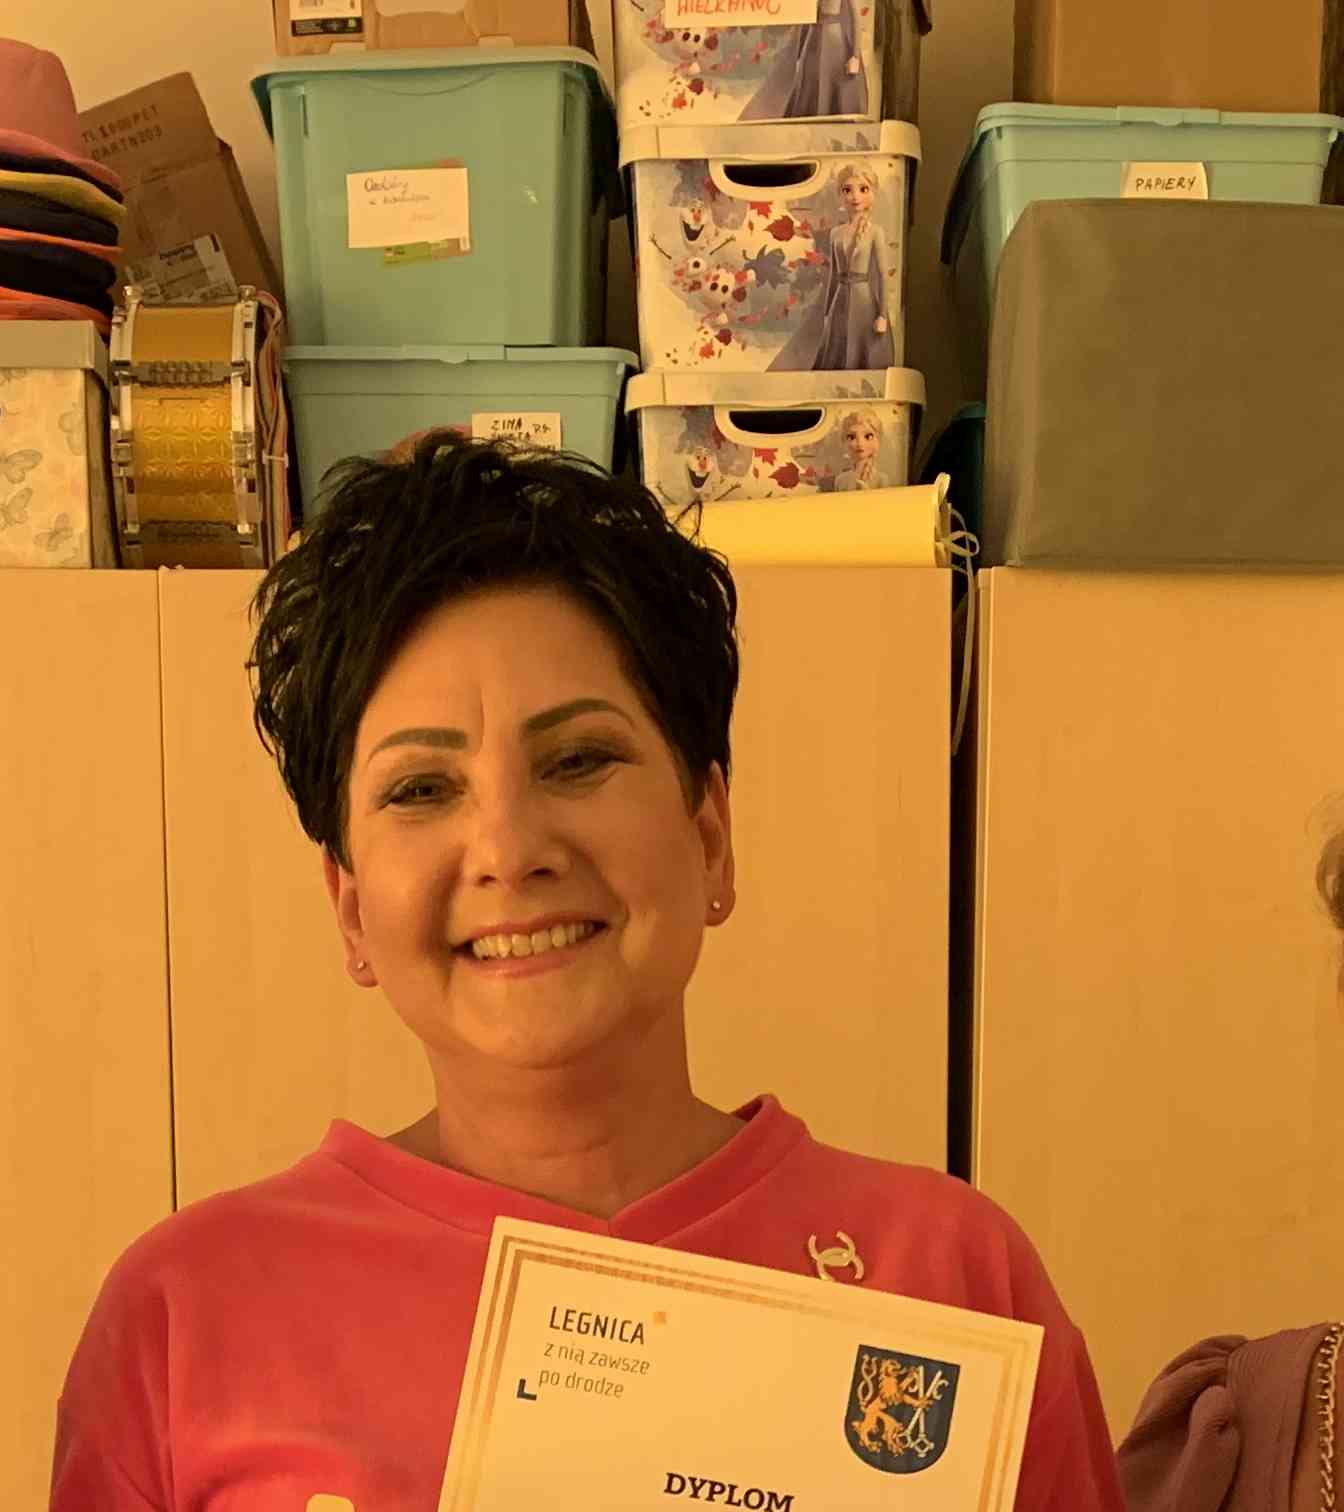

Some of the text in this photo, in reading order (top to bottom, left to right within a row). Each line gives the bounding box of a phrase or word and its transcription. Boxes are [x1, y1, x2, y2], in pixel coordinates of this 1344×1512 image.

[1136, 176, 1196, 192] PAPIERY
[549, 1306, 645, 1346] LEGNICA
[543, 1342, 650, 1376] z nią zawsze
[539, 1369, 625, 1399] po drodze
